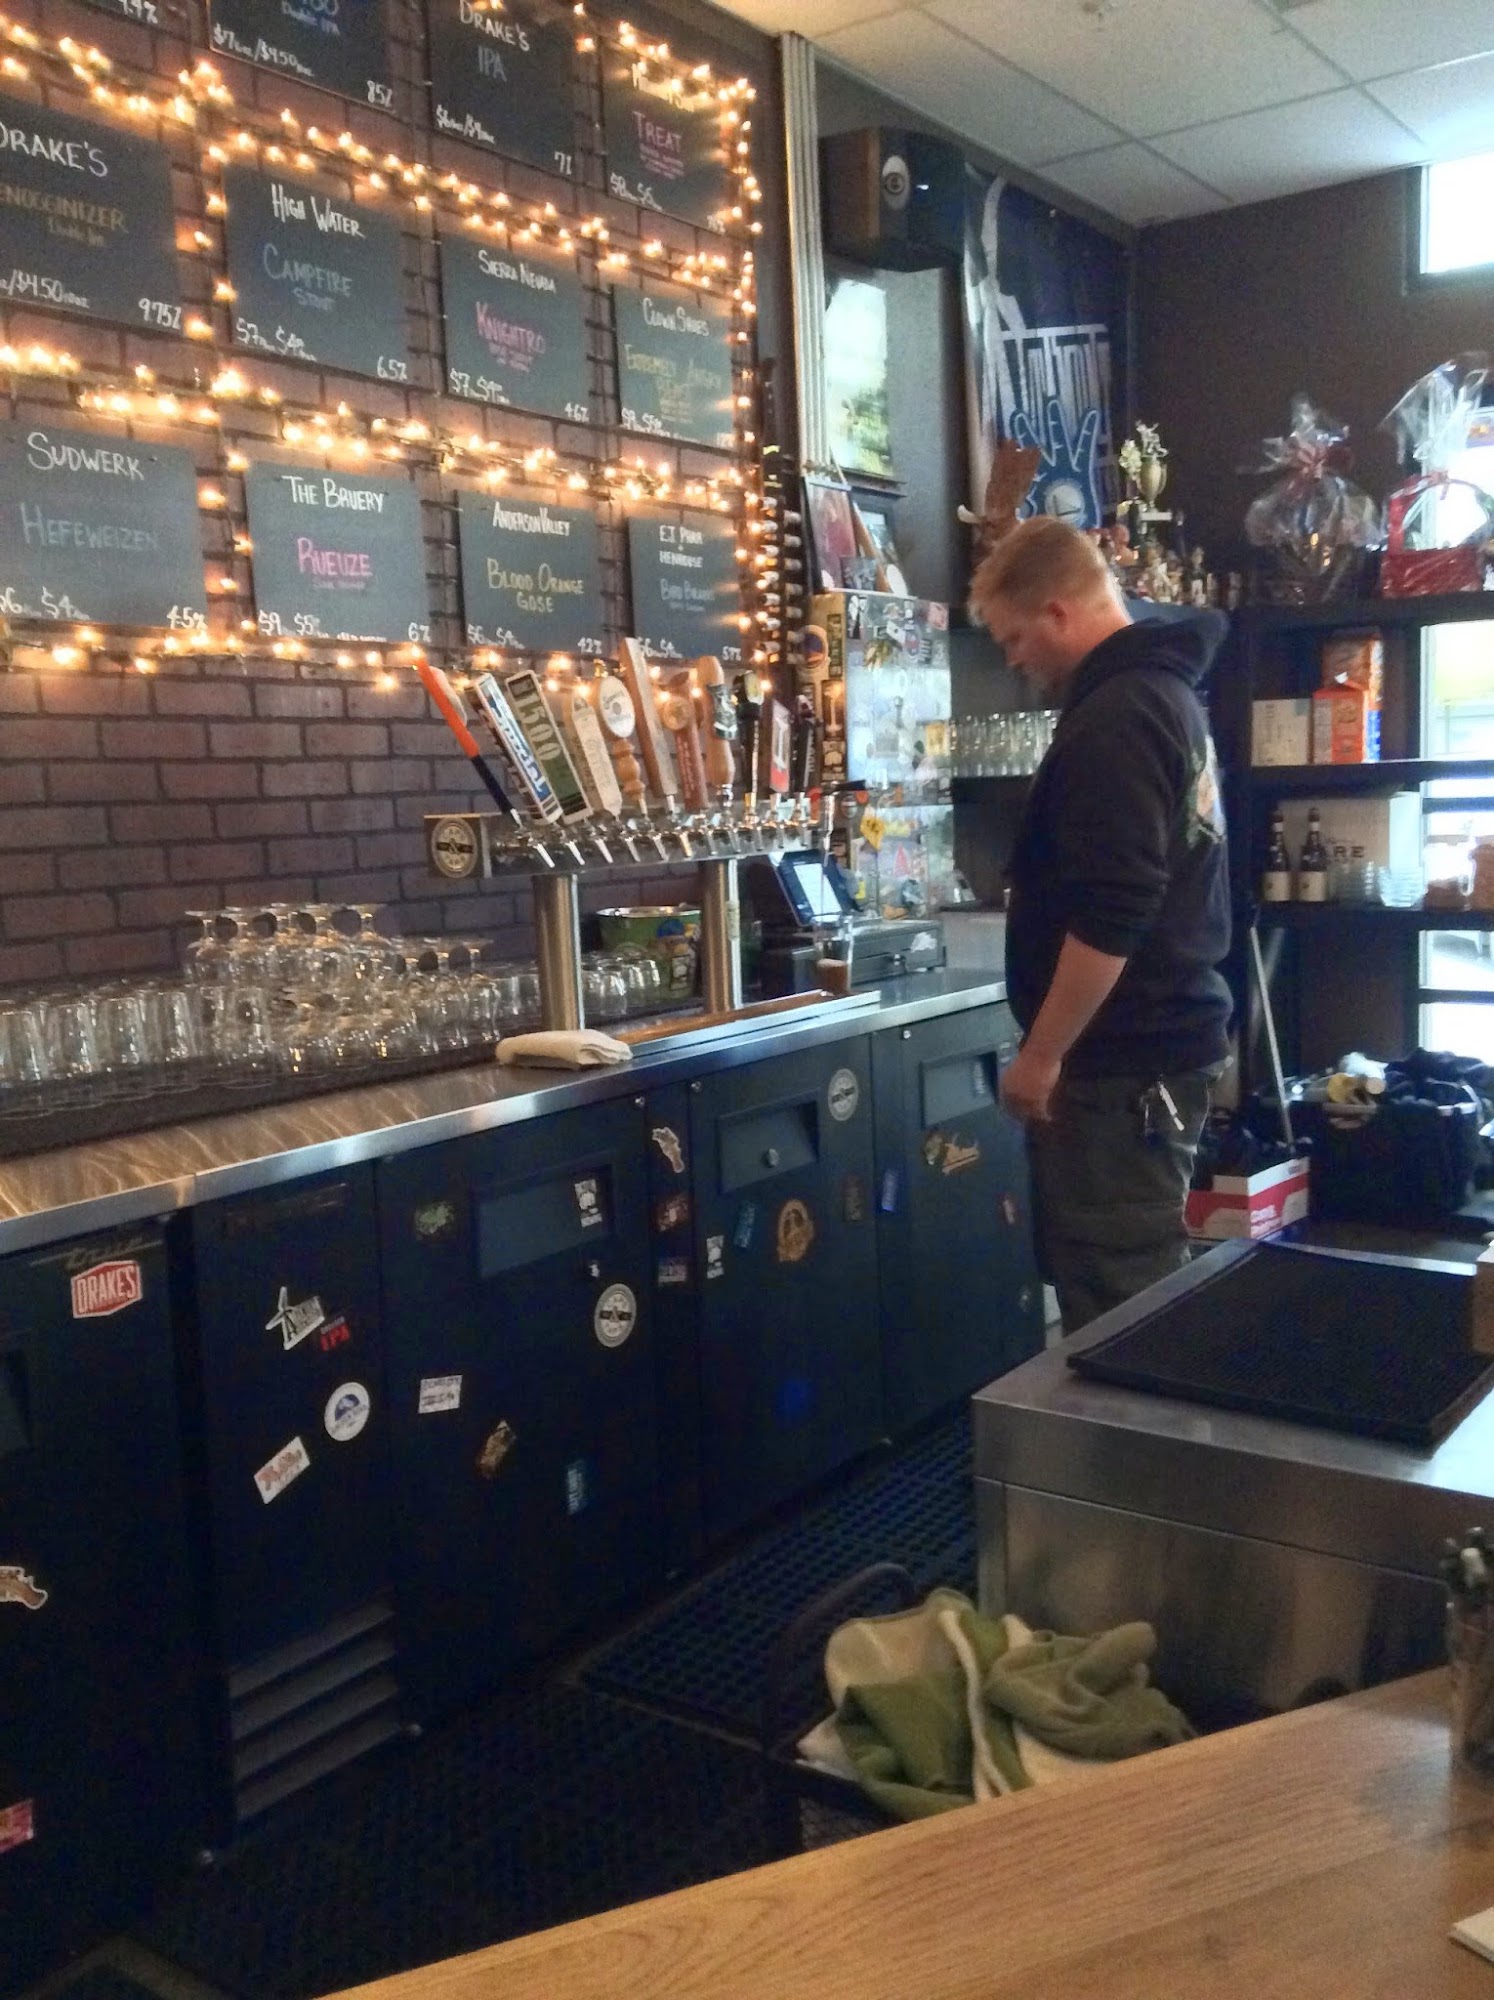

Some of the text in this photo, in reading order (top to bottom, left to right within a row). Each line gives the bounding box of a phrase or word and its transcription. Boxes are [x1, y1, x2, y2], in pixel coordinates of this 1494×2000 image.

[477, 45, 508, 82] IPA
[632, 110, 682, 152] TREAT
[310, 195, 366, 239] WATER
[263, 242, 353, 297] CAMPFIRE
[27, 431, 144, 480] SUDWERK
[281, 475, 319, 505] THE
[486, 557, 534, 591] BLOOD
[516, 591, 554, 614] GOSE
[514, 692, 561, 761] 1500
